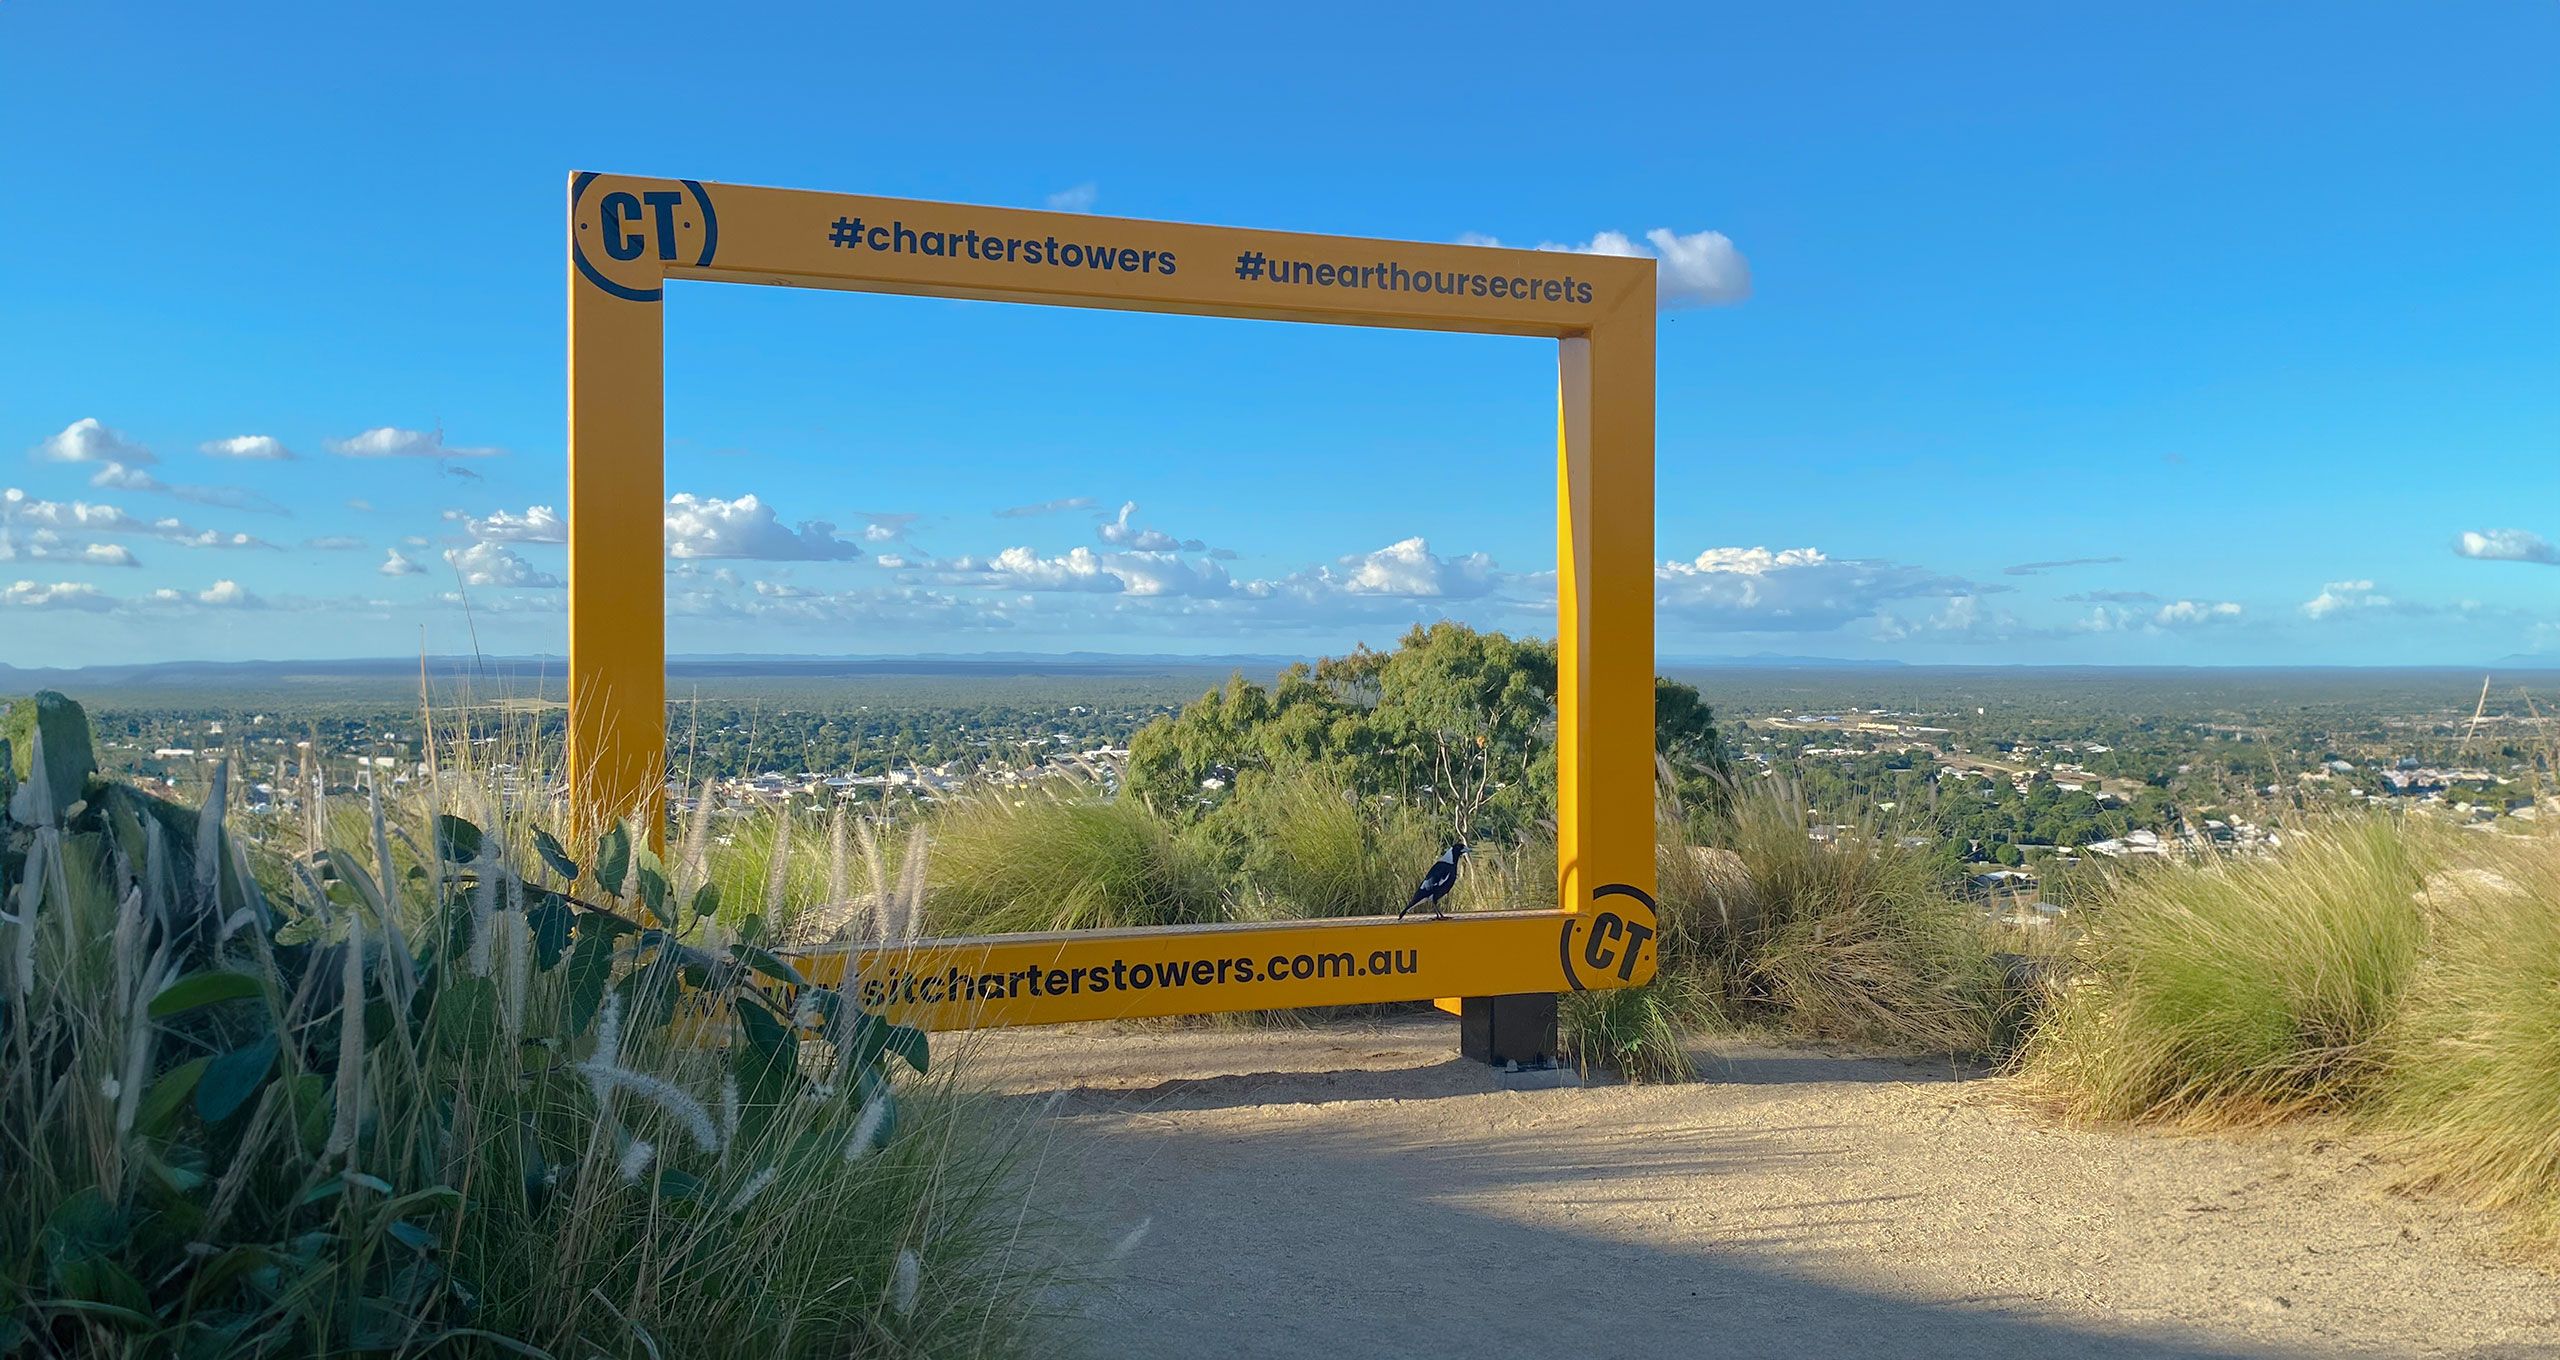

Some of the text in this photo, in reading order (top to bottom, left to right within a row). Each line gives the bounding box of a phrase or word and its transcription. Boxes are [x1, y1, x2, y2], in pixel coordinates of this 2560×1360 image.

[601, 192, 682, 261] CT
[829, 216, 1593, 304] #charterstowers #unearthoursecrets
[1585, 912, 1653, 982] CT
